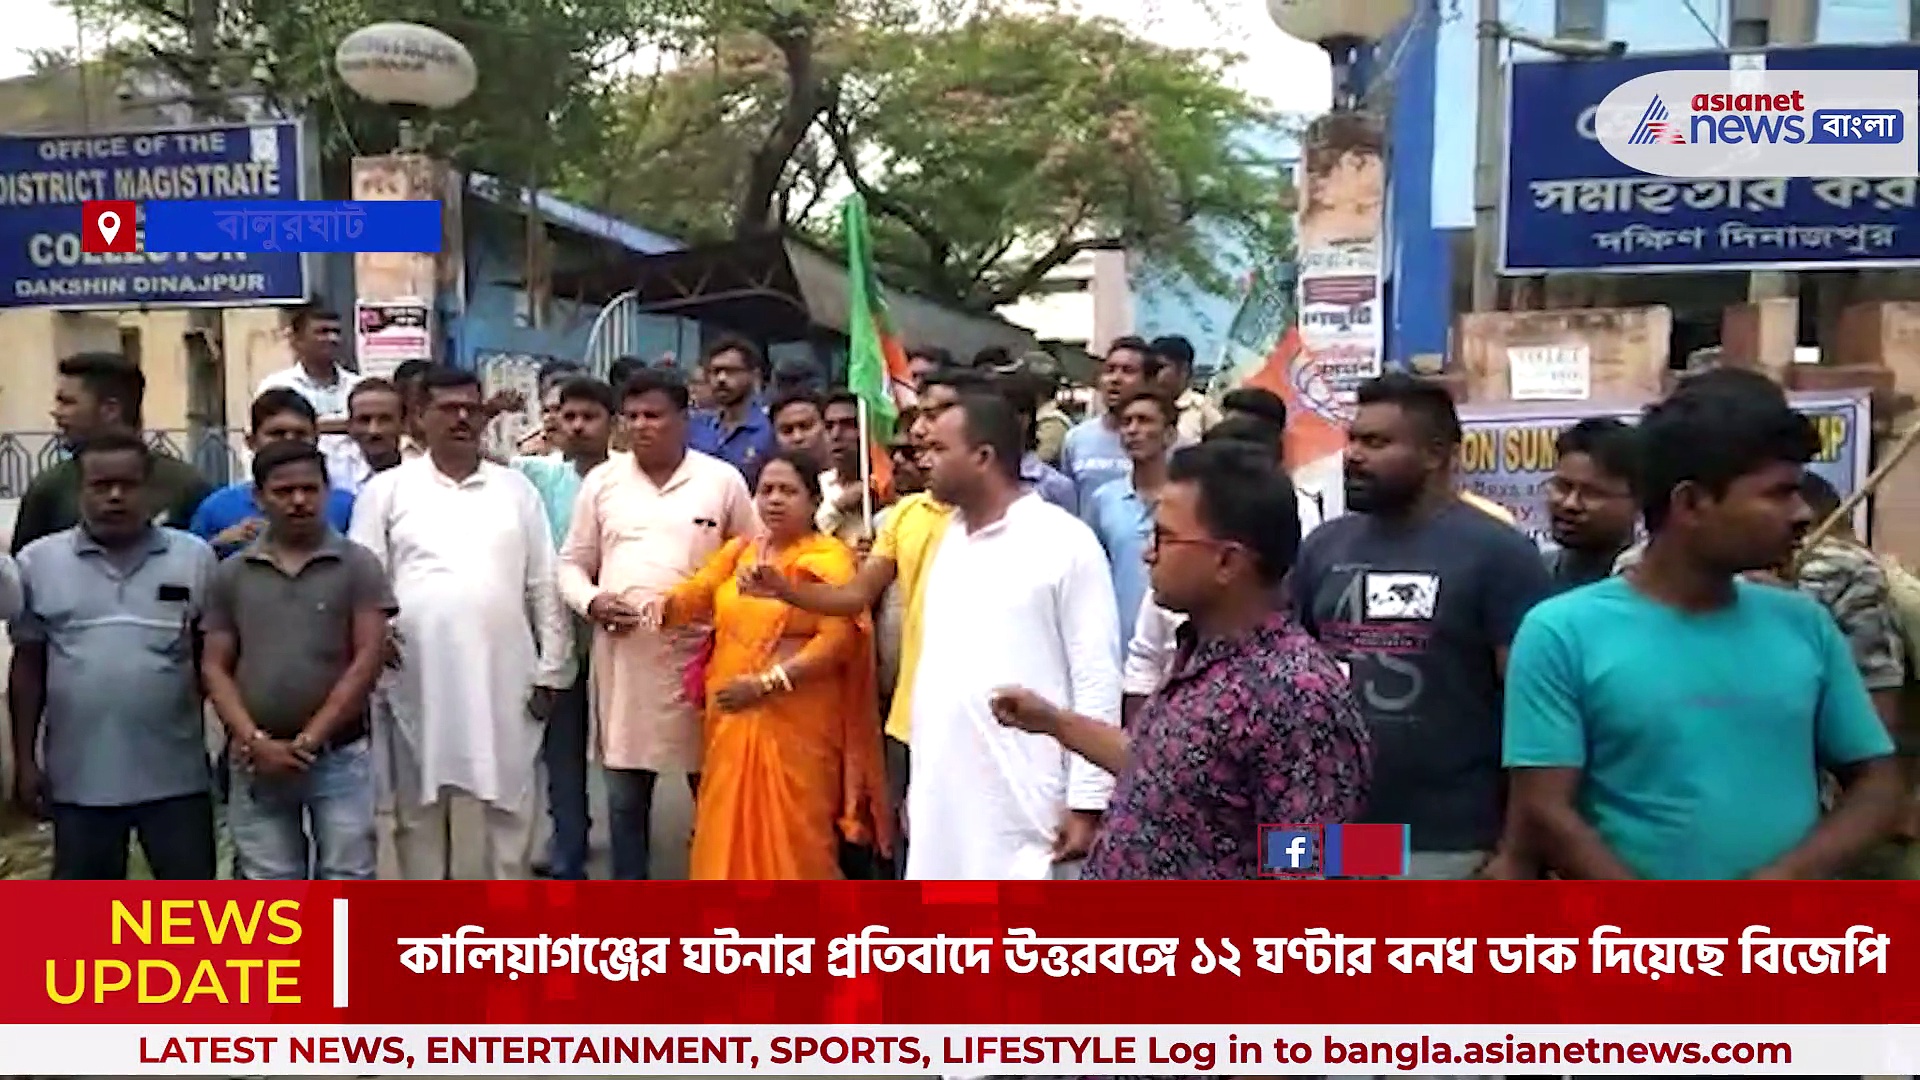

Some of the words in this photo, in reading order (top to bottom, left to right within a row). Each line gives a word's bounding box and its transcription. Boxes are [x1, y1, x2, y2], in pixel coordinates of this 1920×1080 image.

[38, 136, 129, 162] OFFICE
[133, 134, 168, 157] OF
[173, 131, 227, 154] THE
[114, 161, 281, 201] MAGISTRATE
[1593, 221, 1707, 255] দক্ষিণ
[1718, 219, 1899, 255] দিনাজপুর
[15, 275, 127, 299] DAKSHIN
[133, 272, 265, 295] DINAJPUR
